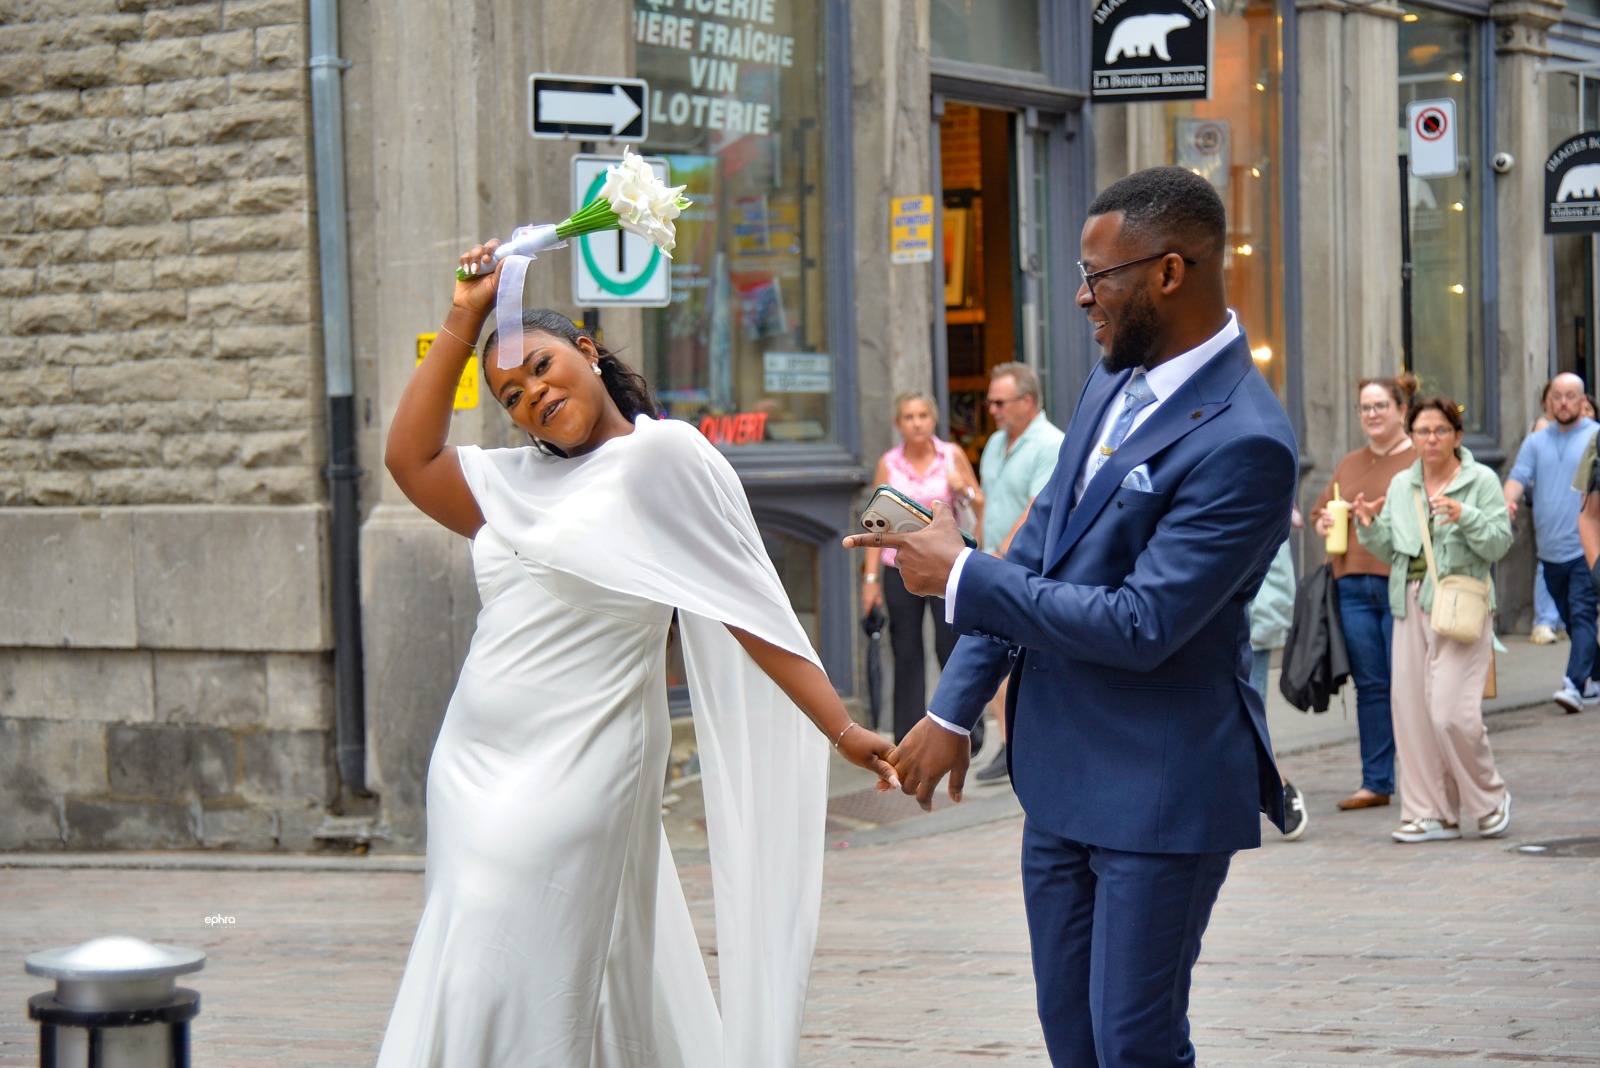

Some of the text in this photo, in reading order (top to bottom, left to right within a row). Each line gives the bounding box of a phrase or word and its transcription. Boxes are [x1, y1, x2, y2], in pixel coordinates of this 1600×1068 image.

[632, 3, 795, 68] IÈRE FRAÎCHE
[689, 56, 739, 92] VIN
[1093, 74, 1109, 89] La
[1110, 73, 1161, 88] Boutique
[651, 90, 771, 135] LOTERIE
[1546, 138, 1588, 173] IMAGES
[699, 411, 768, 446] OUVERT
